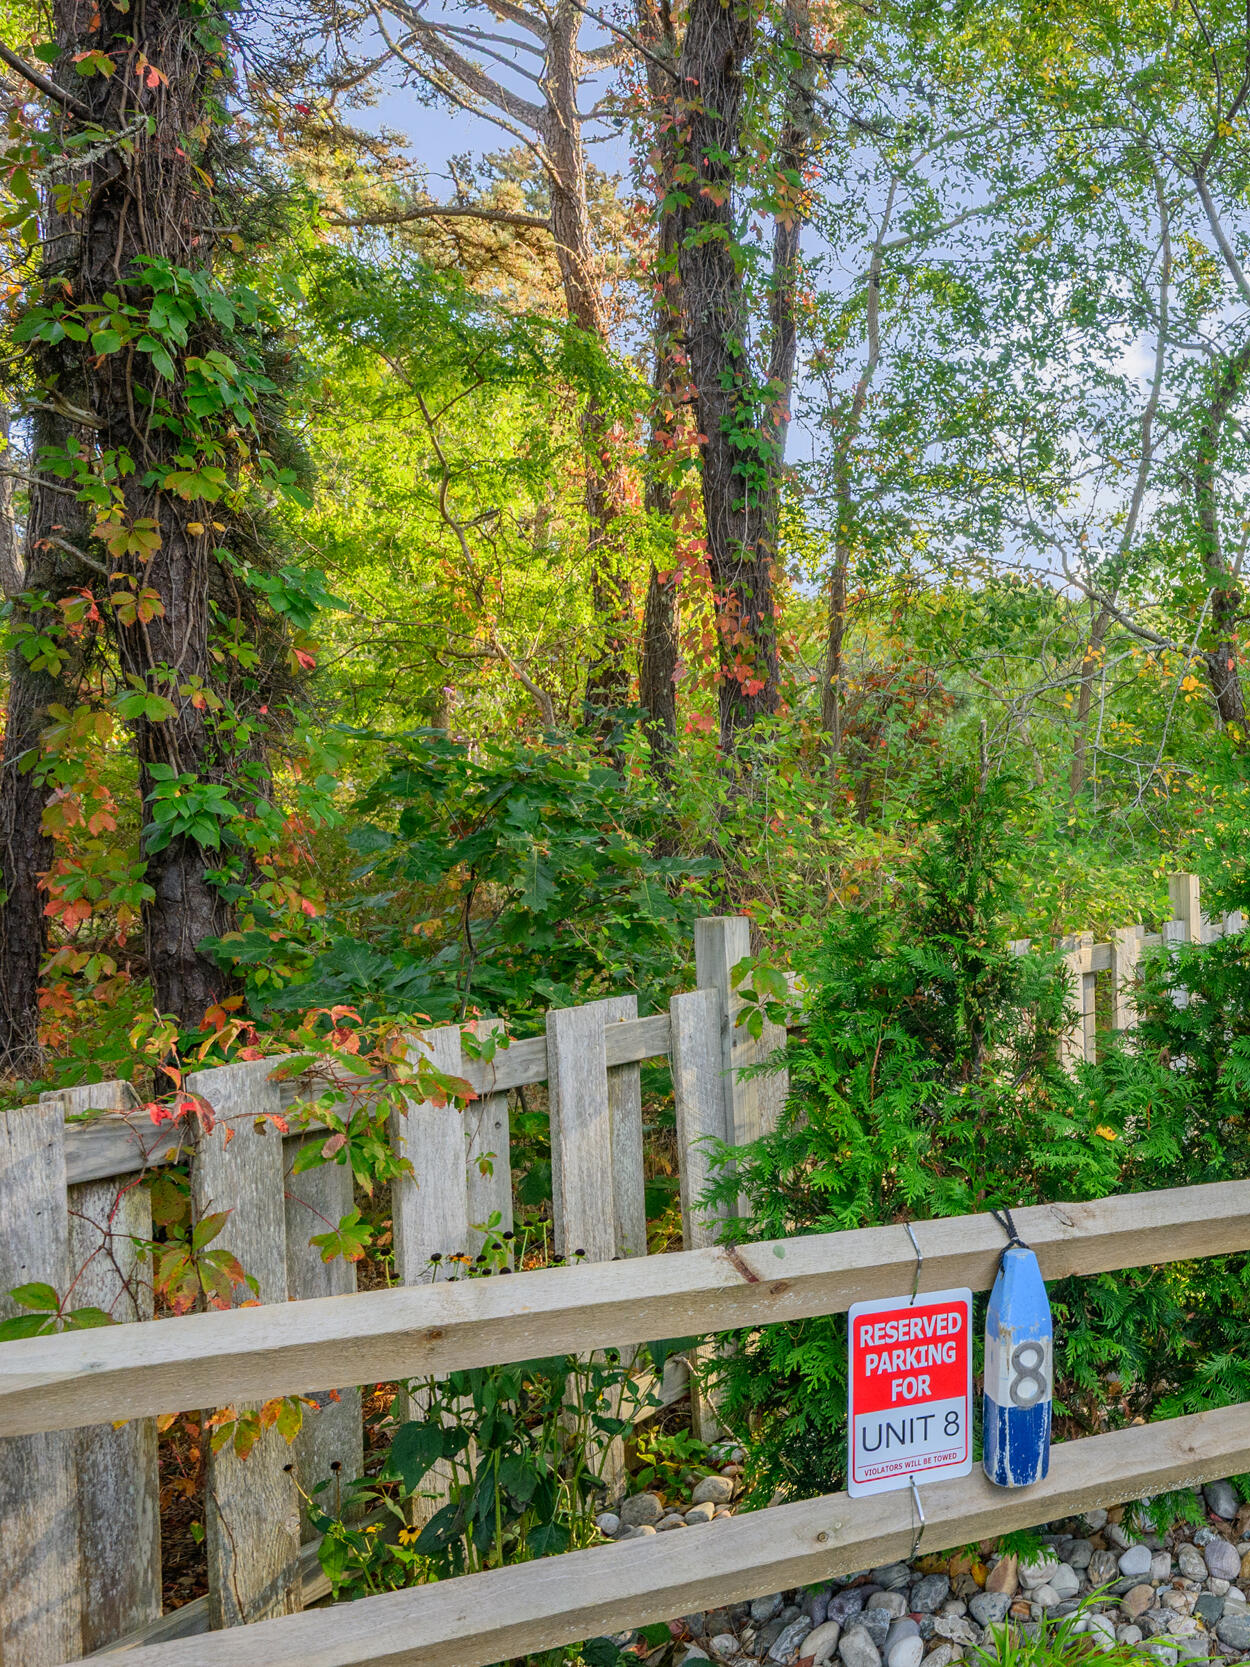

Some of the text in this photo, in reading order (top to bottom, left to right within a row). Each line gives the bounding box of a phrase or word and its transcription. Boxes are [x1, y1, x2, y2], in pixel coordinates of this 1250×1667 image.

[860, 1312, 962, 1348] RESERVED
[865, 1341, 957, 1377] PARKING
[1009, 1341, 1048, 1411] 8
[891, 1374, 932, 1402] FOR
[862, 1410, 960, 1452] UNIT 8
[864, 1452, 958, 1477] VIOLATORS WILL BE TOWED
